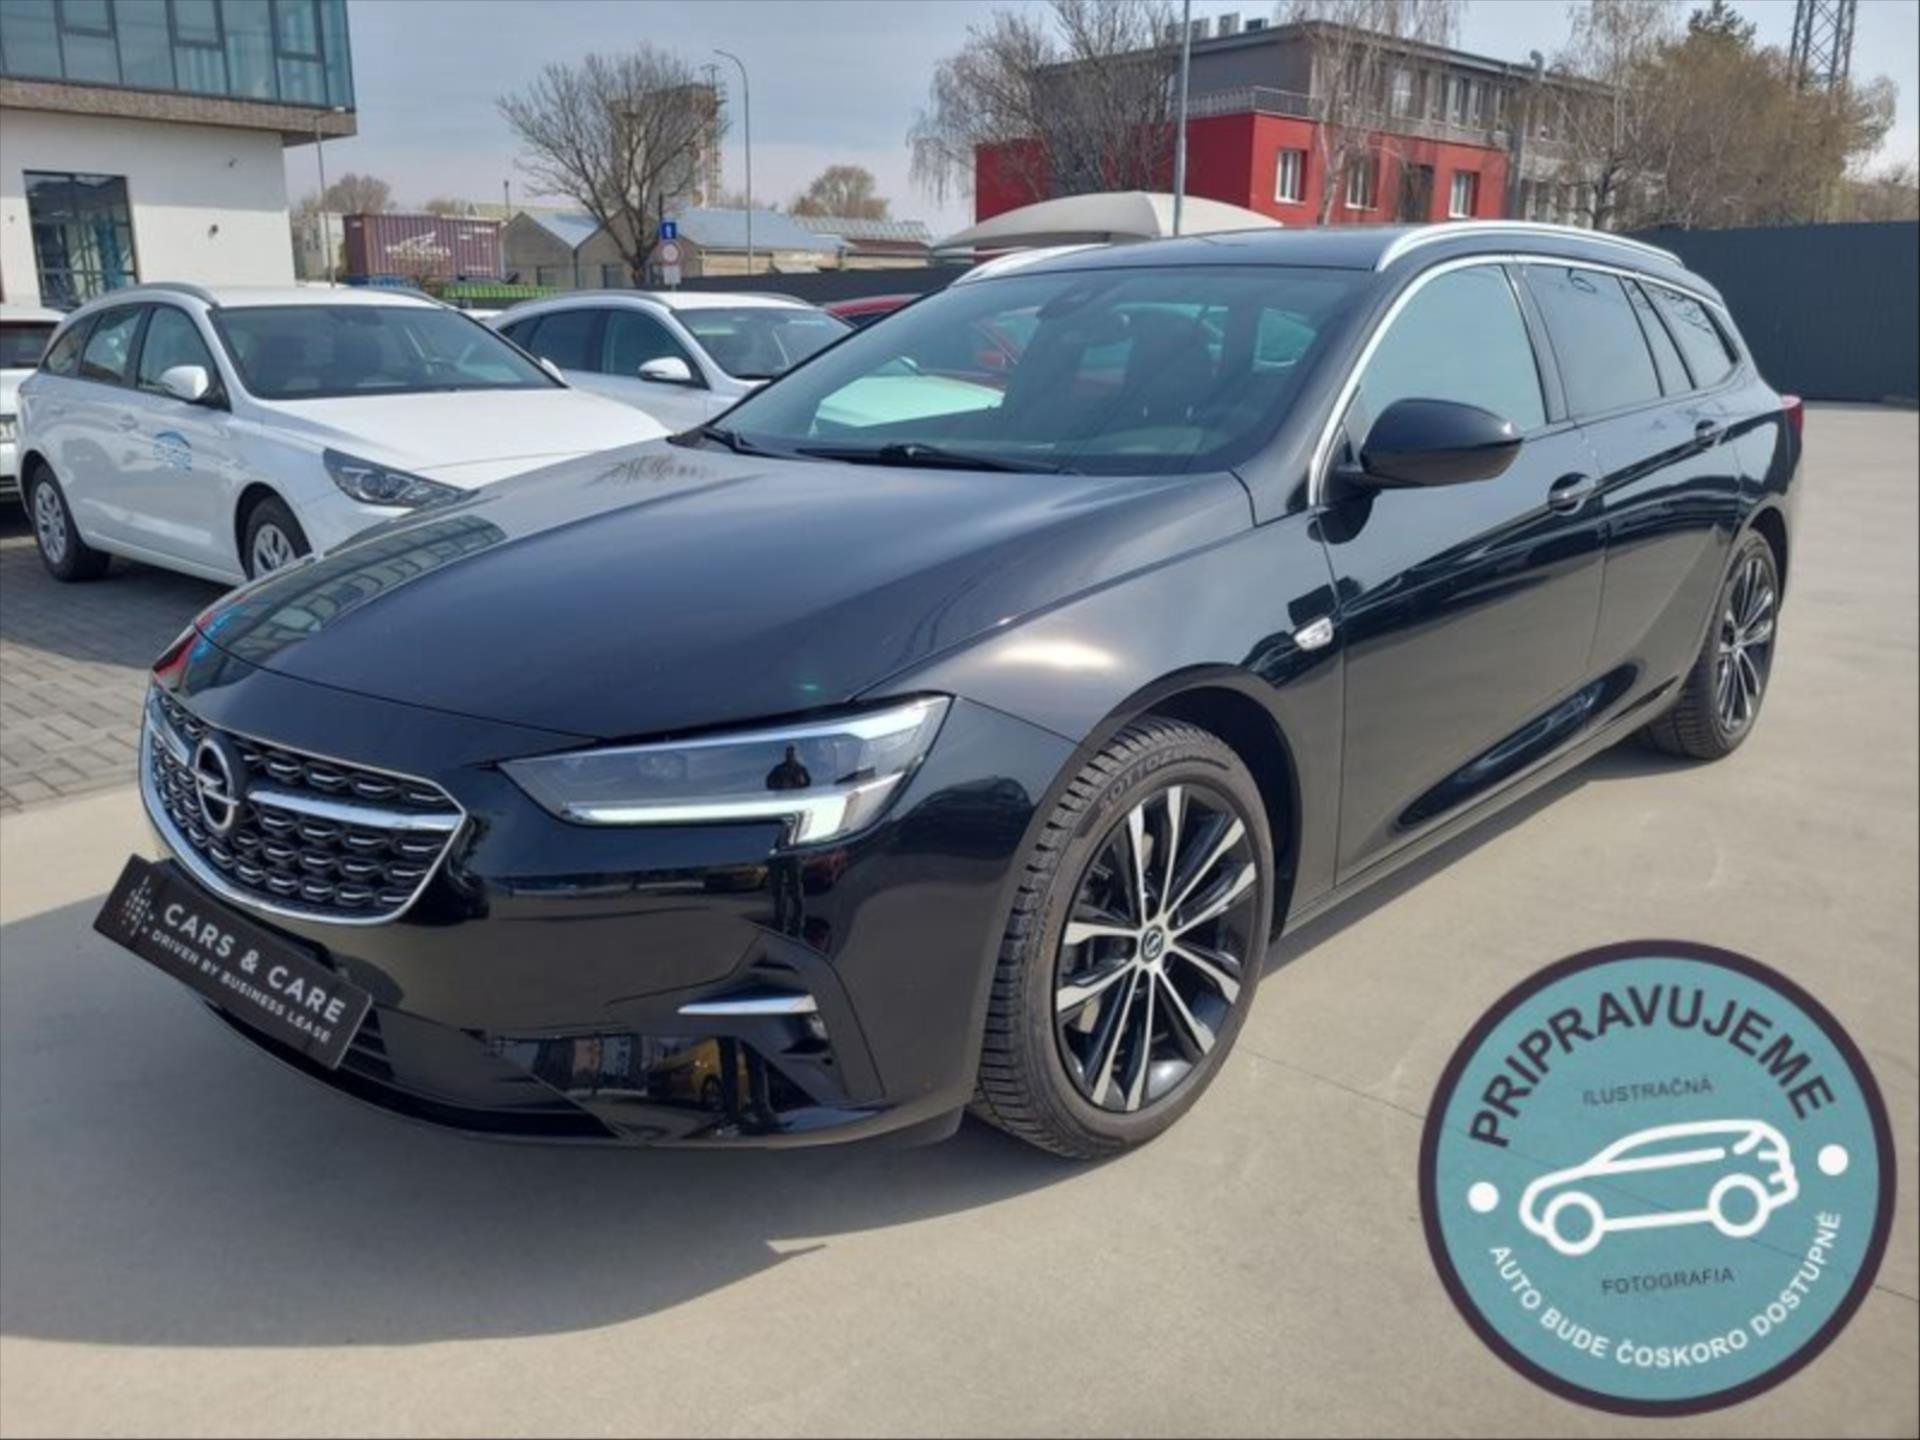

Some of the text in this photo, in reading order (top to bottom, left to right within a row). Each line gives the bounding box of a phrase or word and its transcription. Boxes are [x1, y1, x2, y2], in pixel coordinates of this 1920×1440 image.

[152, 929, 331, 1042] DRIVEN BY BUSINESS LEASE
[165, 904, 345, 1023] CARS & CARE
